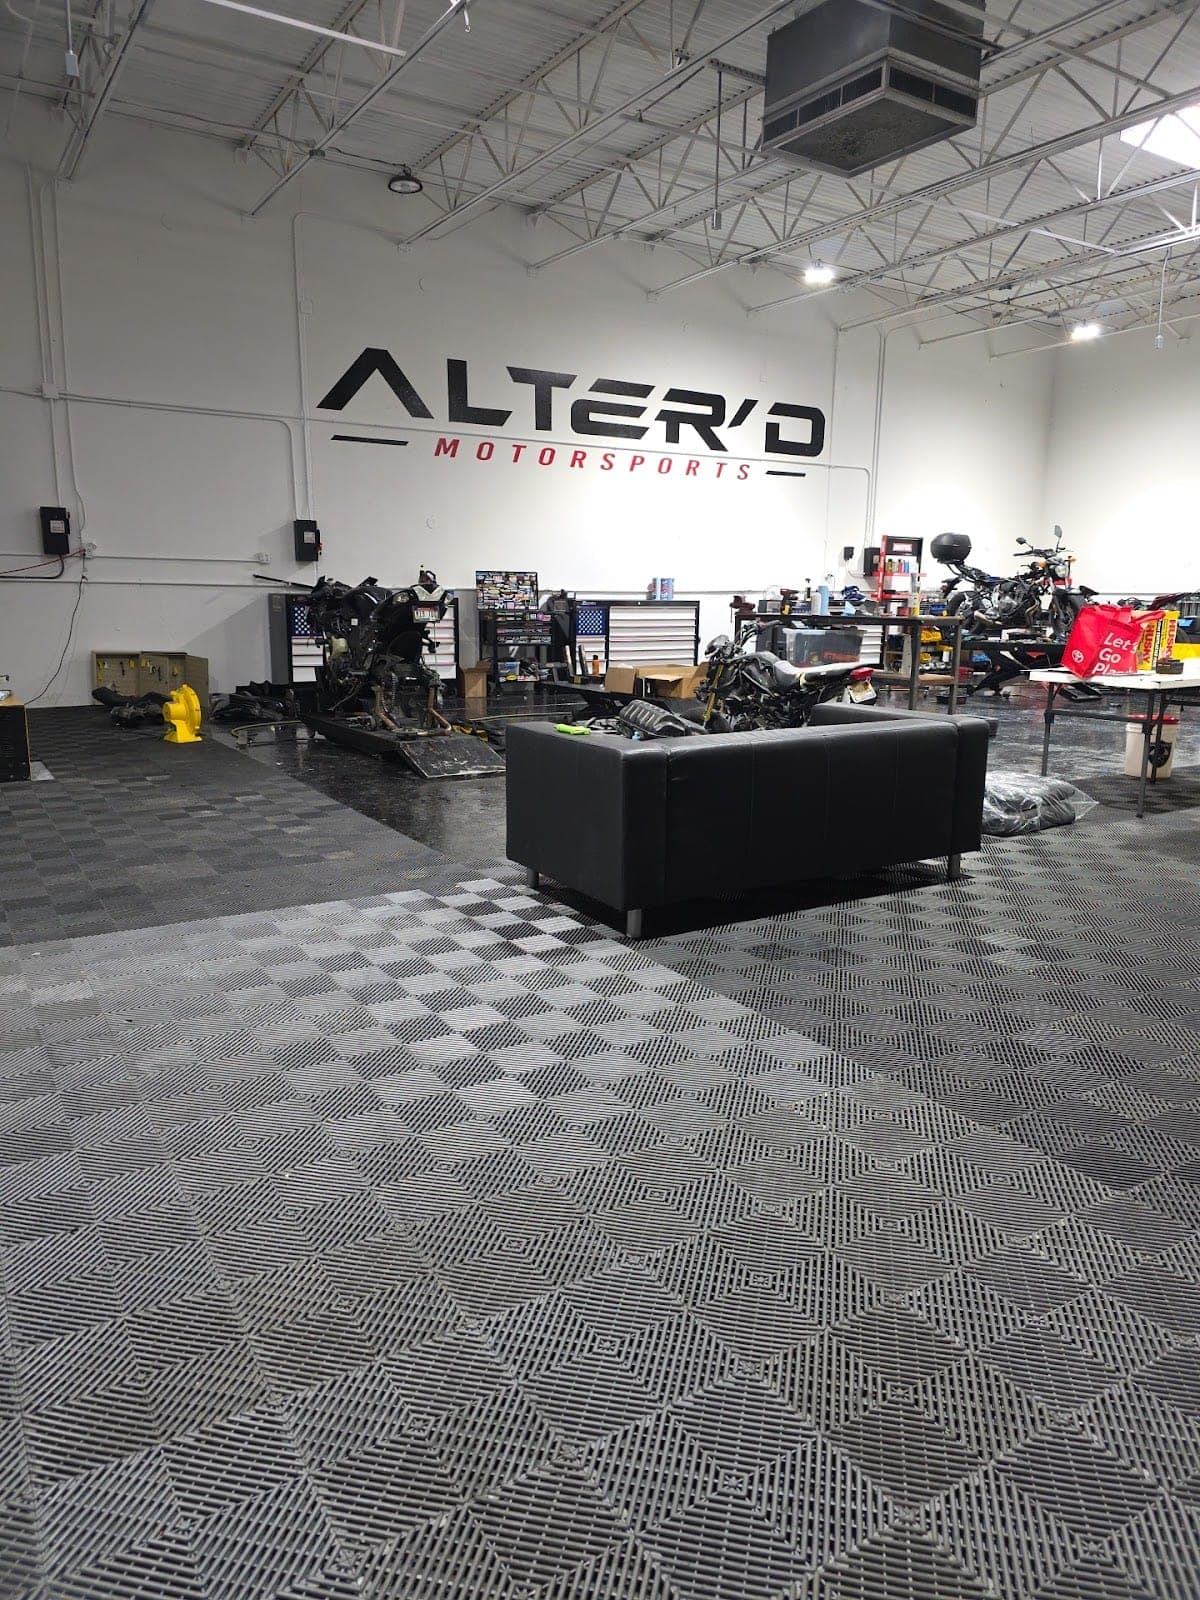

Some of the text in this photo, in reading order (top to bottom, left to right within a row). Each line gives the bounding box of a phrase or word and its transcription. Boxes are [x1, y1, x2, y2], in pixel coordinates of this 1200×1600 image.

[316, 347, 826, 457] ALTER'D
[434, 437, 751, 480] MOTORSPORTS
[1099, 648, 1121, 663] Go
[1104, 633, 1138, 653] Let's
[1143, 623, 1155, 663] HUSKY
